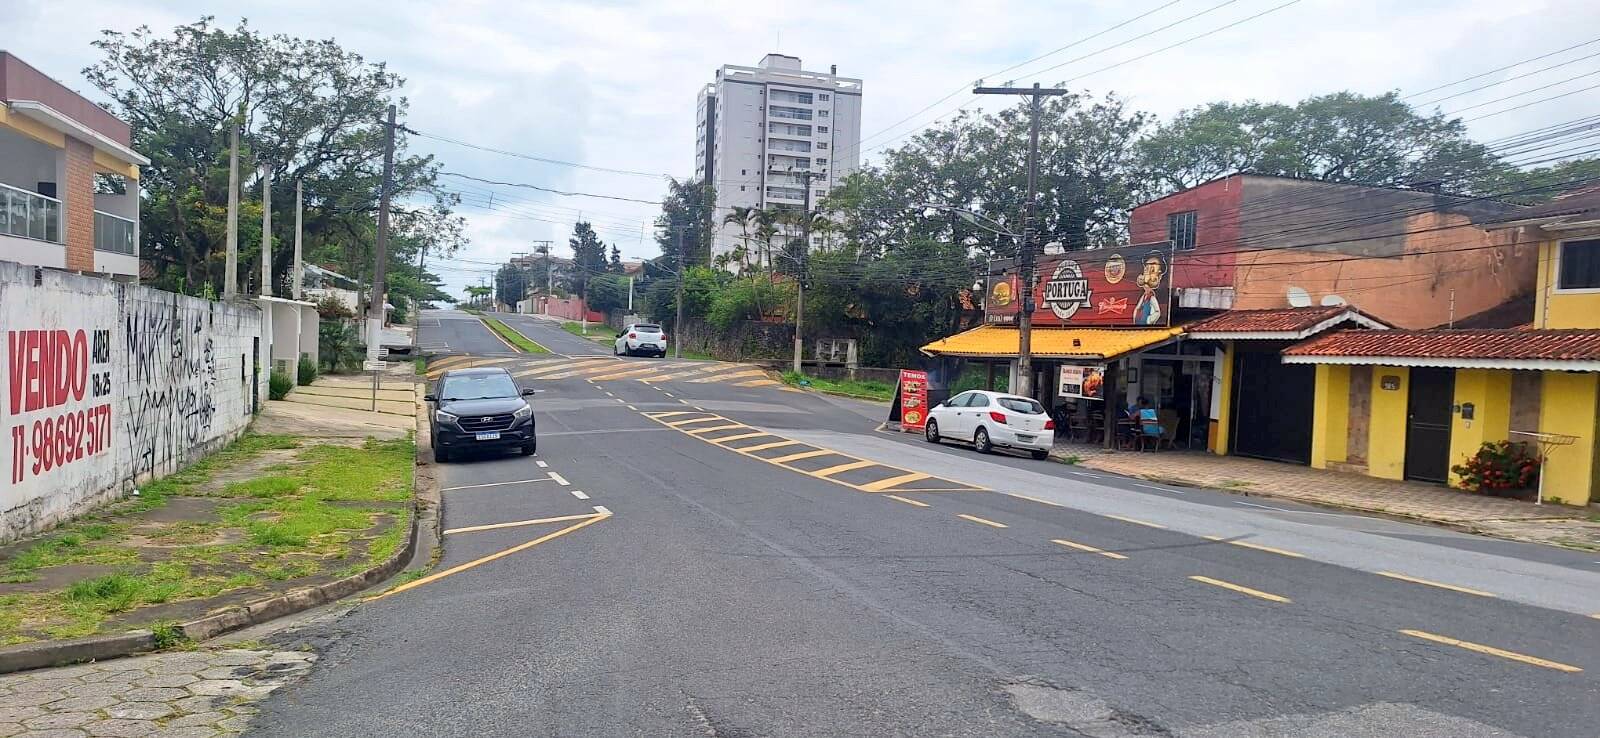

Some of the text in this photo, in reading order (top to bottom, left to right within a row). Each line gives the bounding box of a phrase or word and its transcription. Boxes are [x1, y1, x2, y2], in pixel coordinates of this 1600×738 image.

[1046, 281, 1087, 299] PORTUGA
[8, 329, 88, 416] VENDO
[903, 371, 926, 379] TEMOS
[87, 403, 111, 456] 5171
